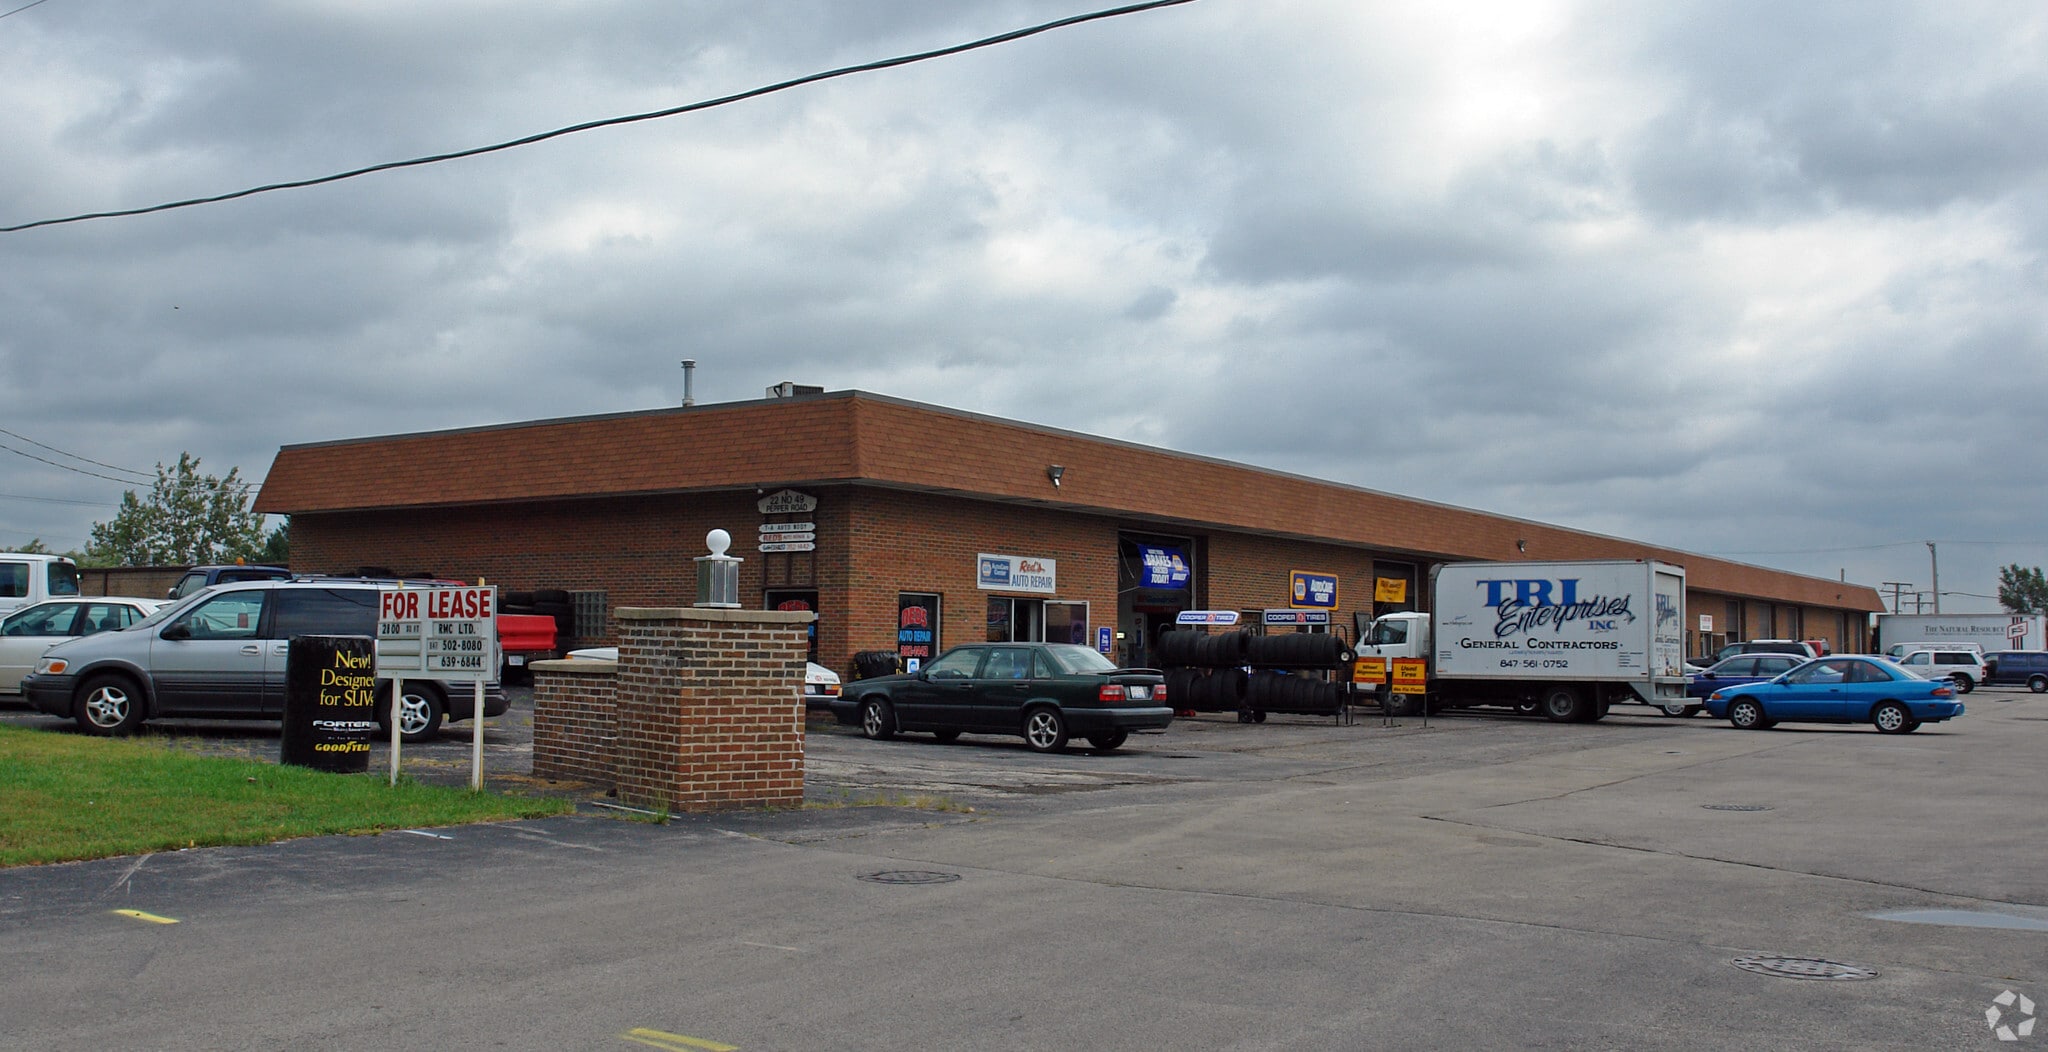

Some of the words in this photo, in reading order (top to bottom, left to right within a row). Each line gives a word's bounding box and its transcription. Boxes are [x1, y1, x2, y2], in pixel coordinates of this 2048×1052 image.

[769, 495, 779, 505] 22
[793, 494, 805, 504] 49
[766, 504, 789, 512] PEPPER
[790, 503, 808, 511] ROAD
[1019, 559, 1046, 573] Red's
[1145, 553, 1172, 568] BRAKES
[1011, 574, 1029, 587] AUTO
[1030, 575, 1053, 588] REPAIR
[1476, 578, 1583, 608] TRI
[382, 592, 419, 620] FOR
[428, 590, 491, 619] LEASE
[1494, 594, 1637, 639] Enterprises
[438, 623, 453, 635] RMC
[458, 623, 476, 635] LTD.
[1587, 619, 1619, 631] INC.
[1940, 625, 1968, 633] NATURAL
[1970, 625, 2005, 633] RESOURCE
[899, 630, 913, 642] AUTO
[914, 630, 931, 642] REPAIR
[442, 640, 483, 651] 502-8080
[1460, 637, 1519, 649] GENERAL
[1526, 637, 1619, 650] CONTRACTORS
[334, 650, 372, 669] New!
[441, 656, 481, 668] 639-6844
[1400, 664, 1418, 672] Used
[320, 688, 341, 706] for
